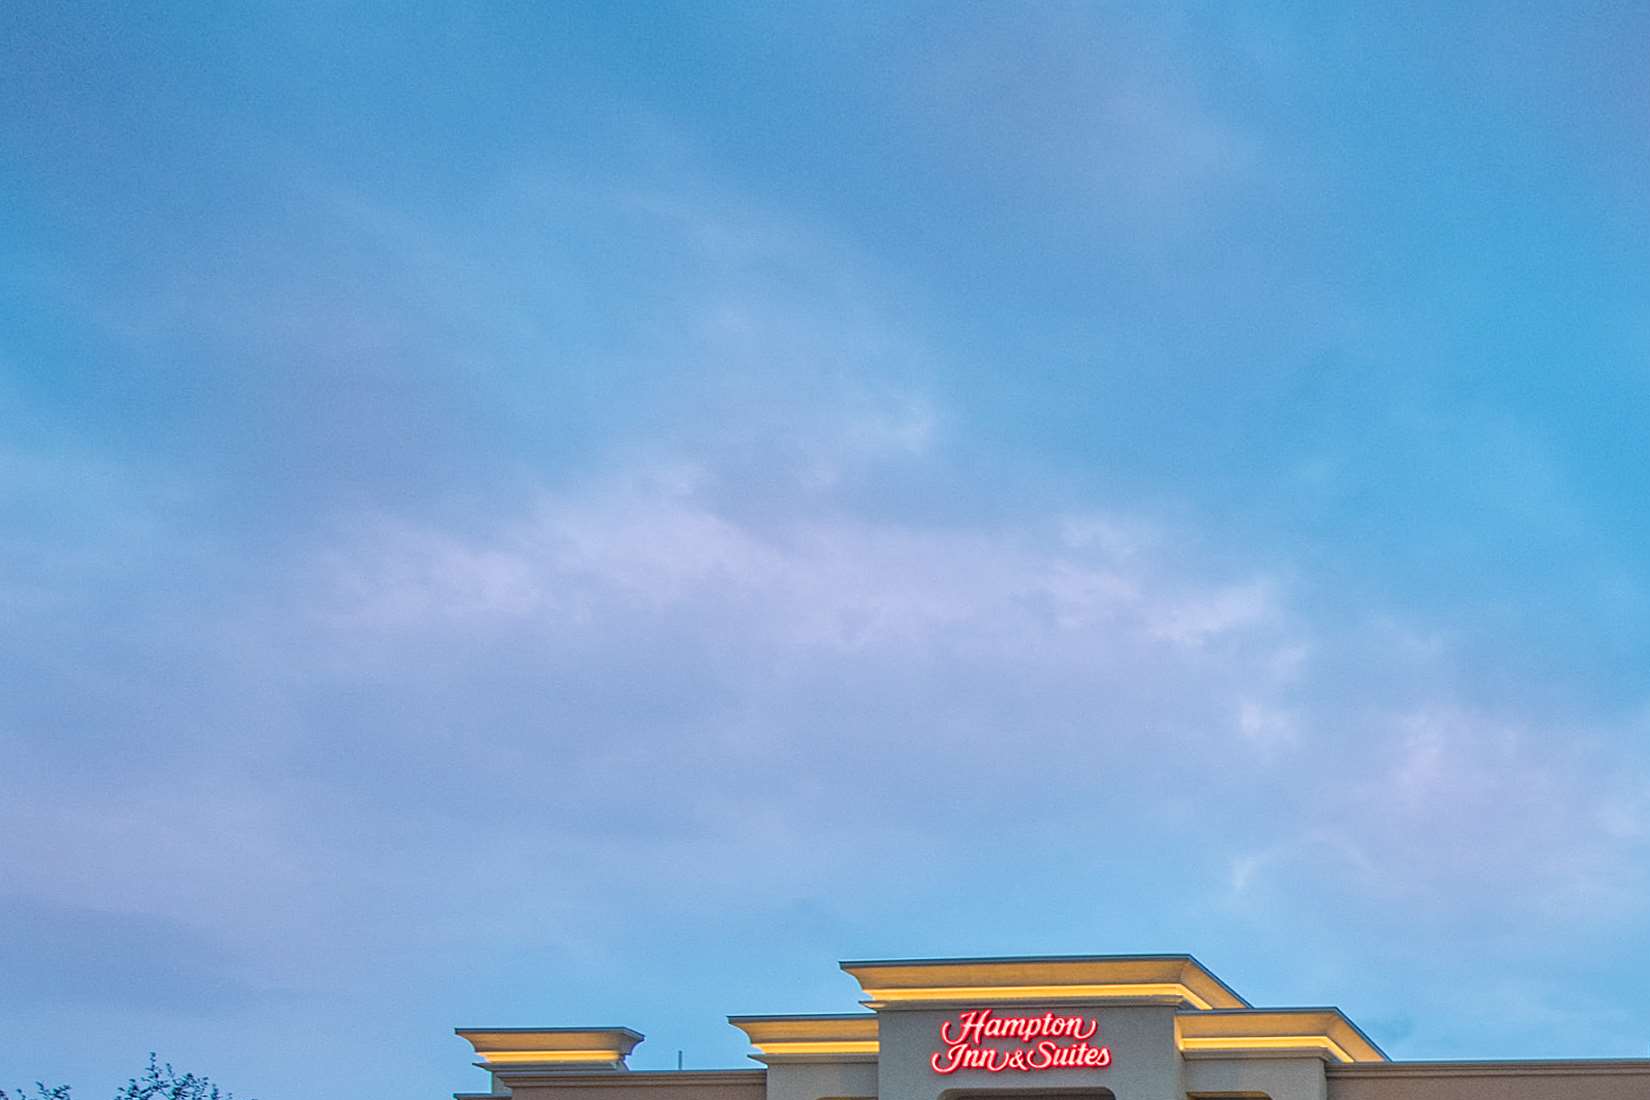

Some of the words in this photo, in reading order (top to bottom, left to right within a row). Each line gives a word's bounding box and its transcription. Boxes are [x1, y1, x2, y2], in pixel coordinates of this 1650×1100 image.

[940, 1008, 1098, 1046] Hampton
[930, 1042, 1009, 1074] Inn
[1008, 1049, 1029, 1072] &
[1026, 1040, 1111, 1069] Suites
